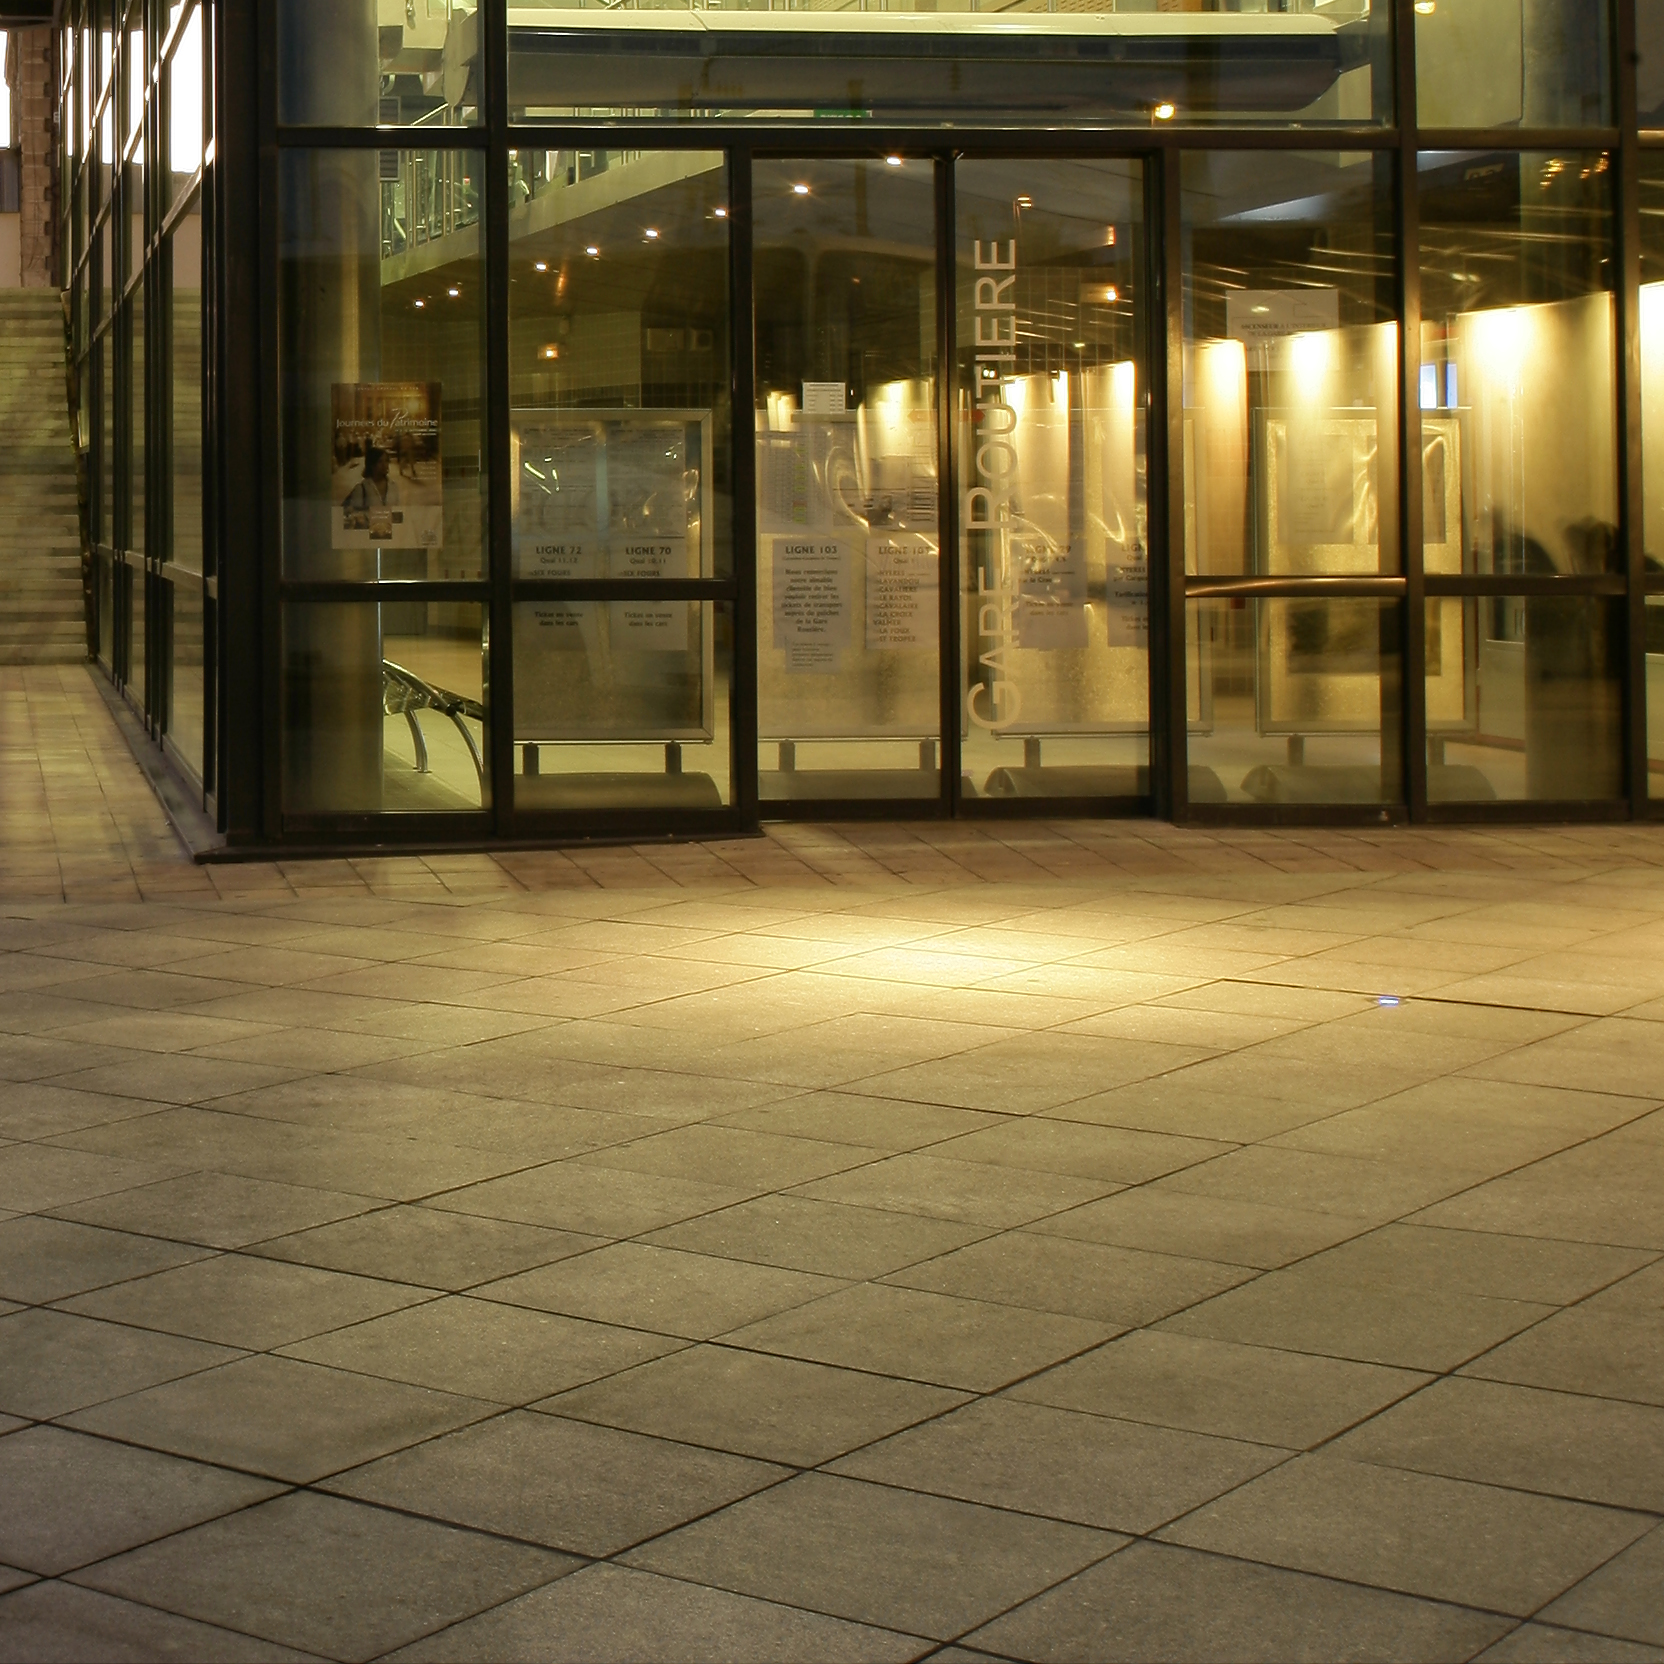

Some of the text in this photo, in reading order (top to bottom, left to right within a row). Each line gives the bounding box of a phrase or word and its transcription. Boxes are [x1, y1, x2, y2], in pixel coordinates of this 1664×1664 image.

[377, 417, 388, 427] du
[389, 408, 438, 429] Patrimoine
[965, 239, 1021, 730] GARE ROUTIERE
[535, 545, 582, 555] LIGNE 72
[625, 546, 672, 555] LIGNE 70
[785, 545, 838, 554] LIGNE 103
[878, 545, 908, 555] LIGNE
